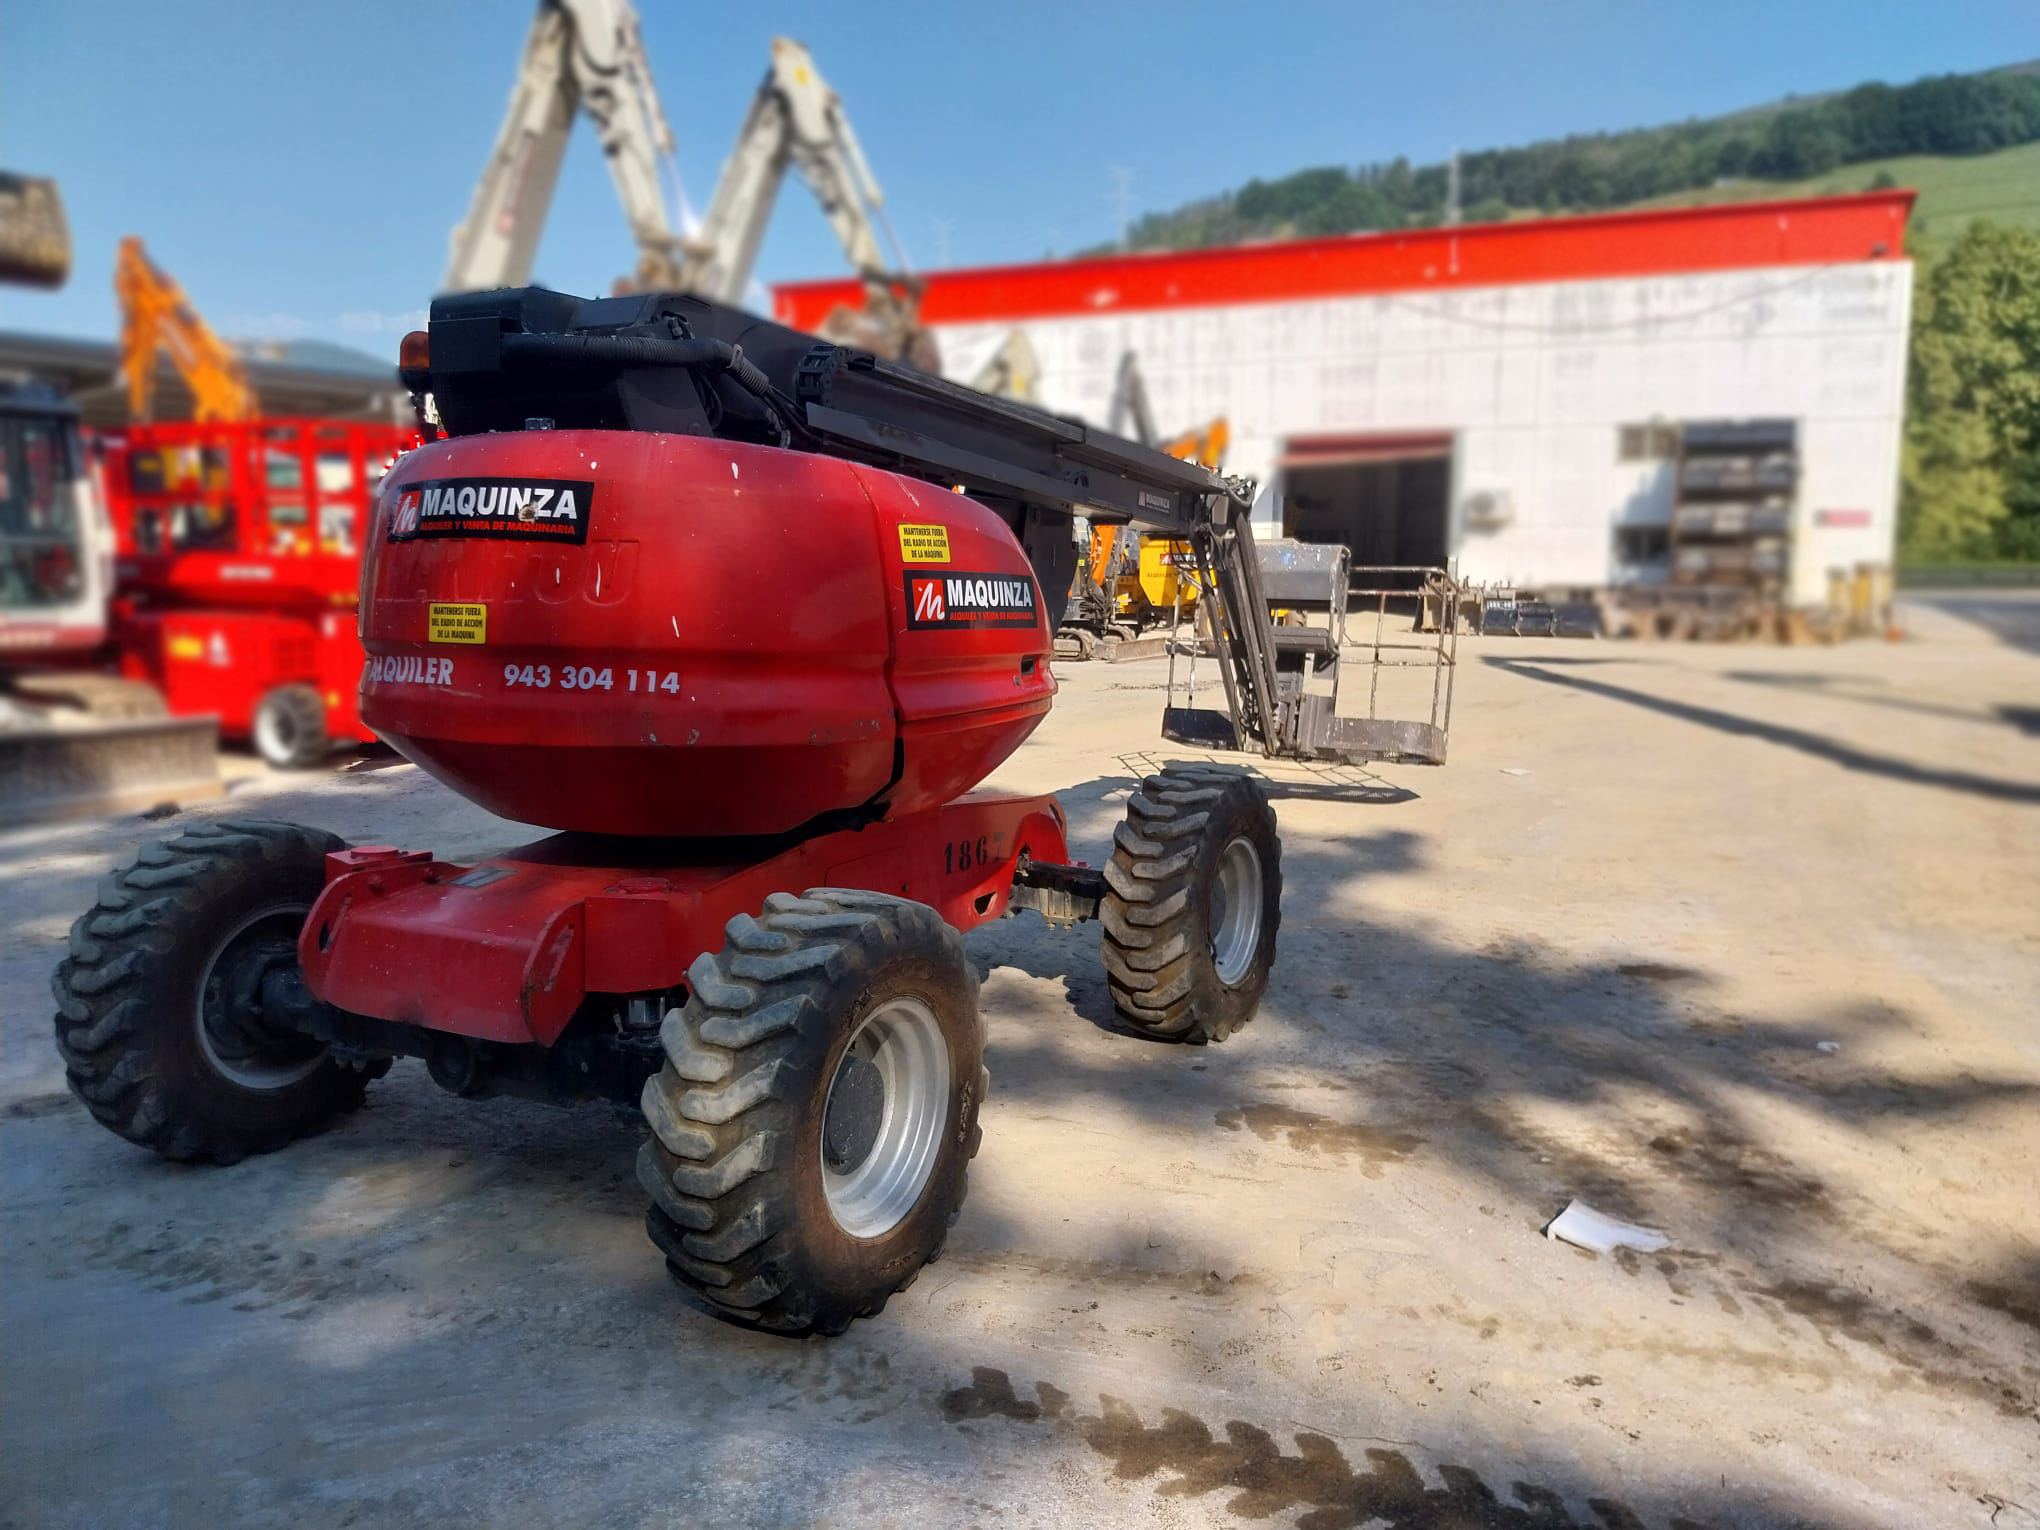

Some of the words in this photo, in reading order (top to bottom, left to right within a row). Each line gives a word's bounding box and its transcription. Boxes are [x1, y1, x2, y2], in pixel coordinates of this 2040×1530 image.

[421, 486, 578, 520] MAQUINZA
[463, 521, 490, 530] VENTA
[492, 521, 504, 530] DE
[507, 521, 576, 535] MAQUINARIA
[904, 528, 931, 536] MANTENERSE
[932, 528, 944, 537] FUERA
[904, 539, 912, 547] DEL
[913, 539, 926, 547] RADIO
[927, 539, 932, 547] DE
[911, 550, 917, 558] DE
[918, 550, 923, 558] LA
[946, 579, 1033, 608] MAQUINZA
[433, 607, 464, 615] MANTENERSE
[465, 607, 481, 616] FUERA
[432, 618, 440, 627] DEL
[441, 618, 455, 627] RADIO
[456, 618, 463, 627] DE
[437, 629, 443, 638] DE
[444, 629, 450, 638] LA
[369, 655, 454, 685] ALQUILER
[504, 664, 551, 688] 943
[560, 666, 614, 690] 304
[627, 669, 680, 694] 114
